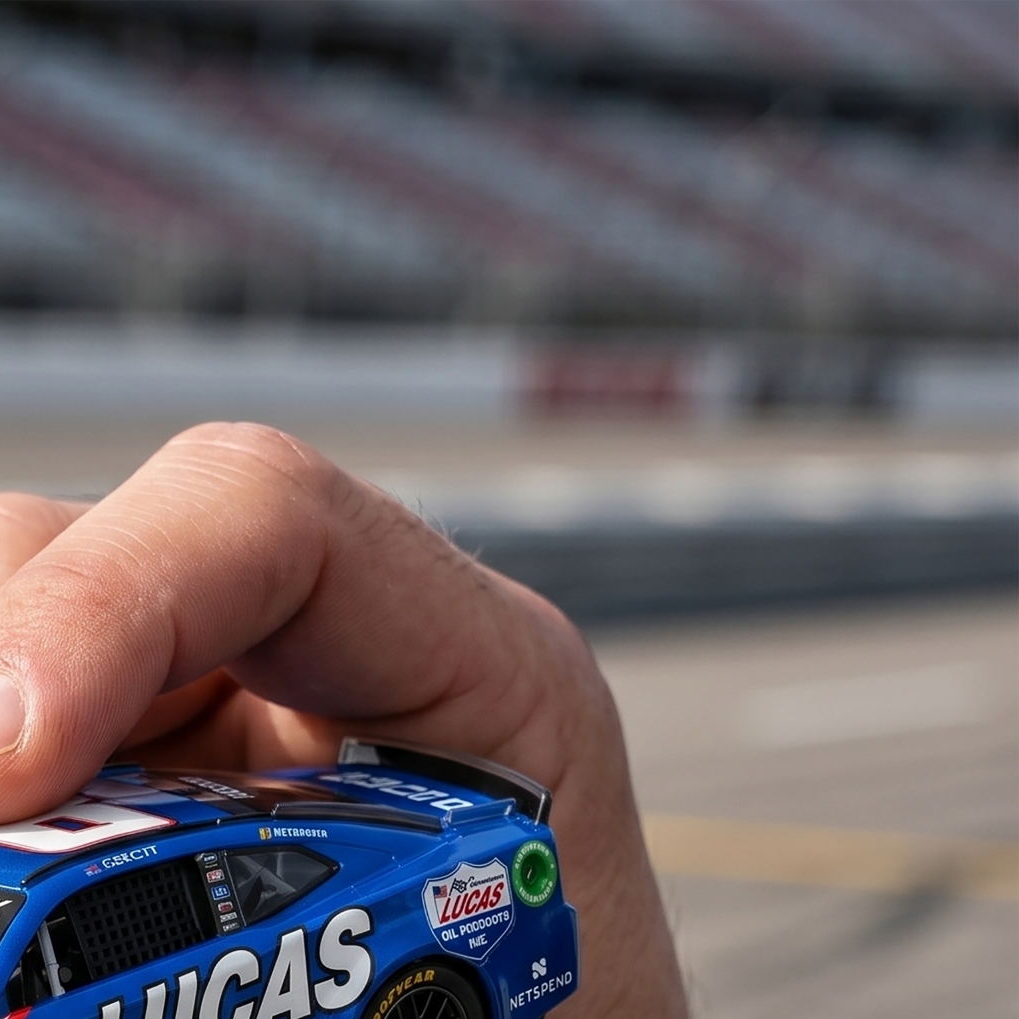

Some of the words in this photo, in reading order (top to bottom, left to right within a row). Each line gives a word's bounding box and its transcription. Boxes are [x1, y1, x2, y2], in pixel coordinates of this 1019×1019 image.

[440, 882, 505, 924] LUCAS
[441, 928, 459, 942] OIL
[509, 971, 573, 1012] NETSPEND
